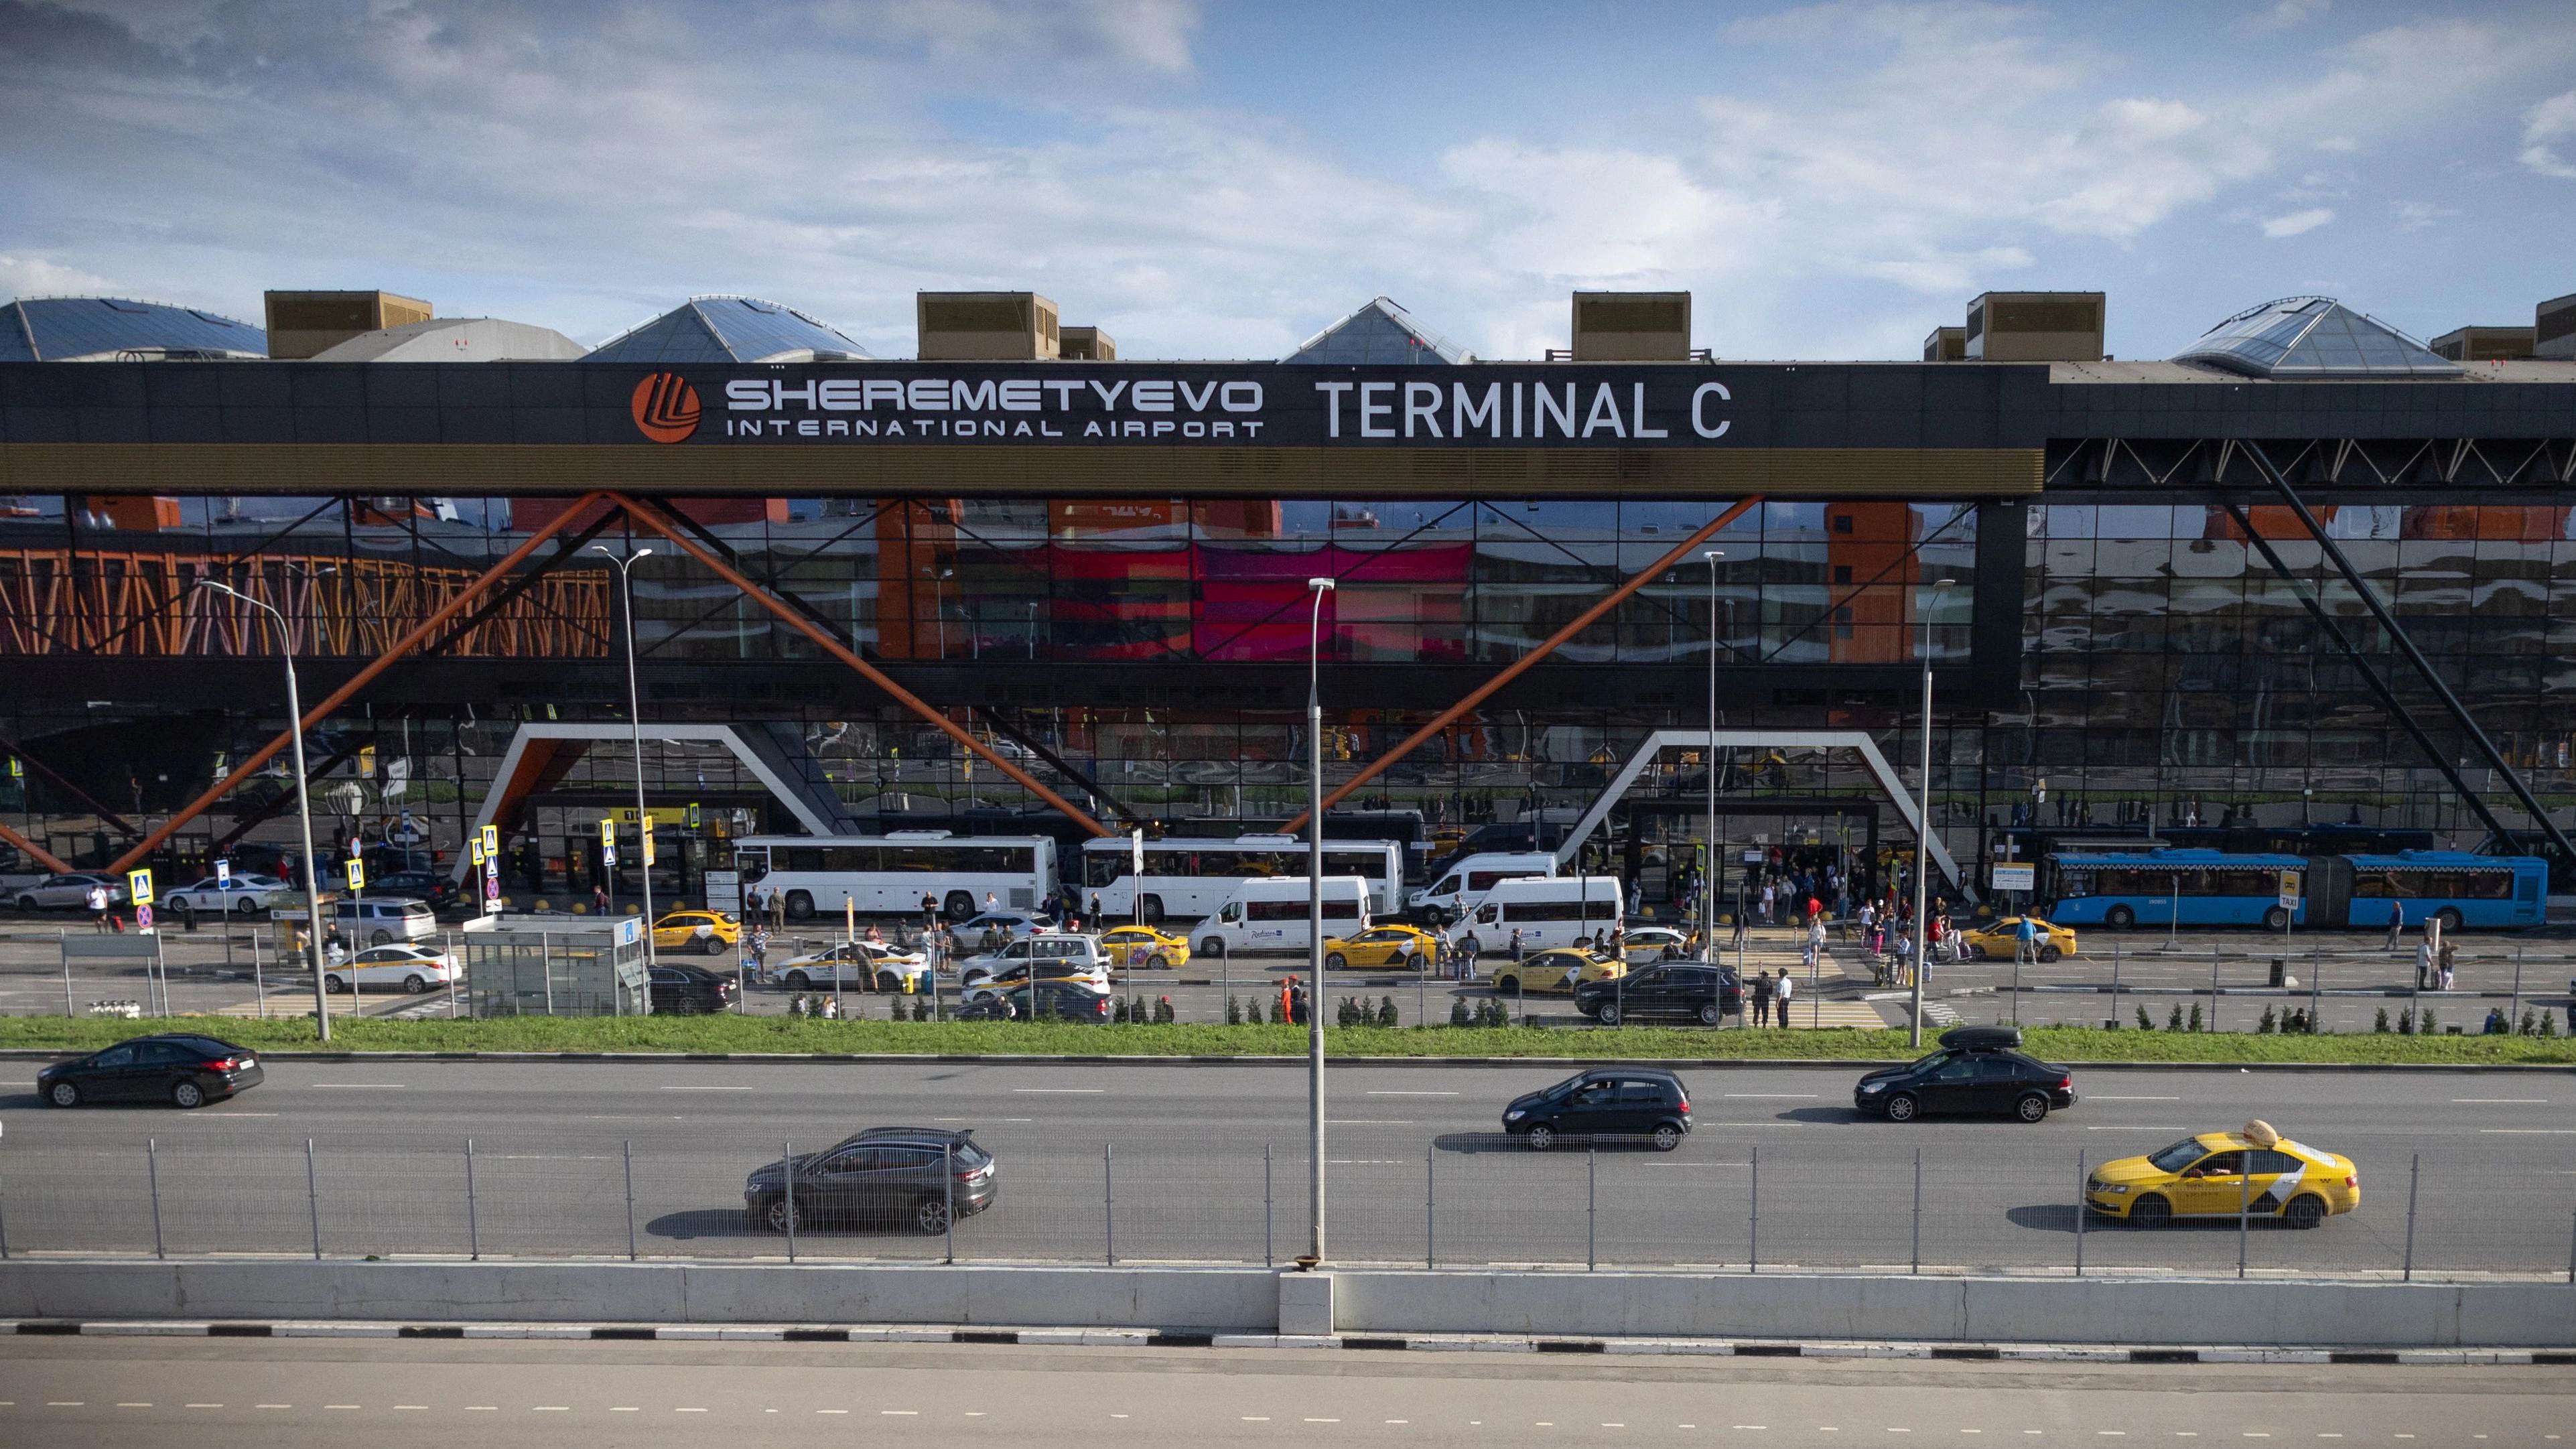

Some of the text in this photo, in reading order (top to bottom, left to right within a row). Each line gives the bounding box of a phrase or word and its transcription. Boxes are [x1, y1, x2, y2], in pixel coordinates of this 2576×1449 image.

[726, 378, 1731, 439] SHEREMETYEVO TERMINAL C
[727, 419, 1264, 437] INTERNATIONAL AIRPORT
[2282, 898, 2297, 906] TAXI
[1251, 930, 1276, 939] Radisson
